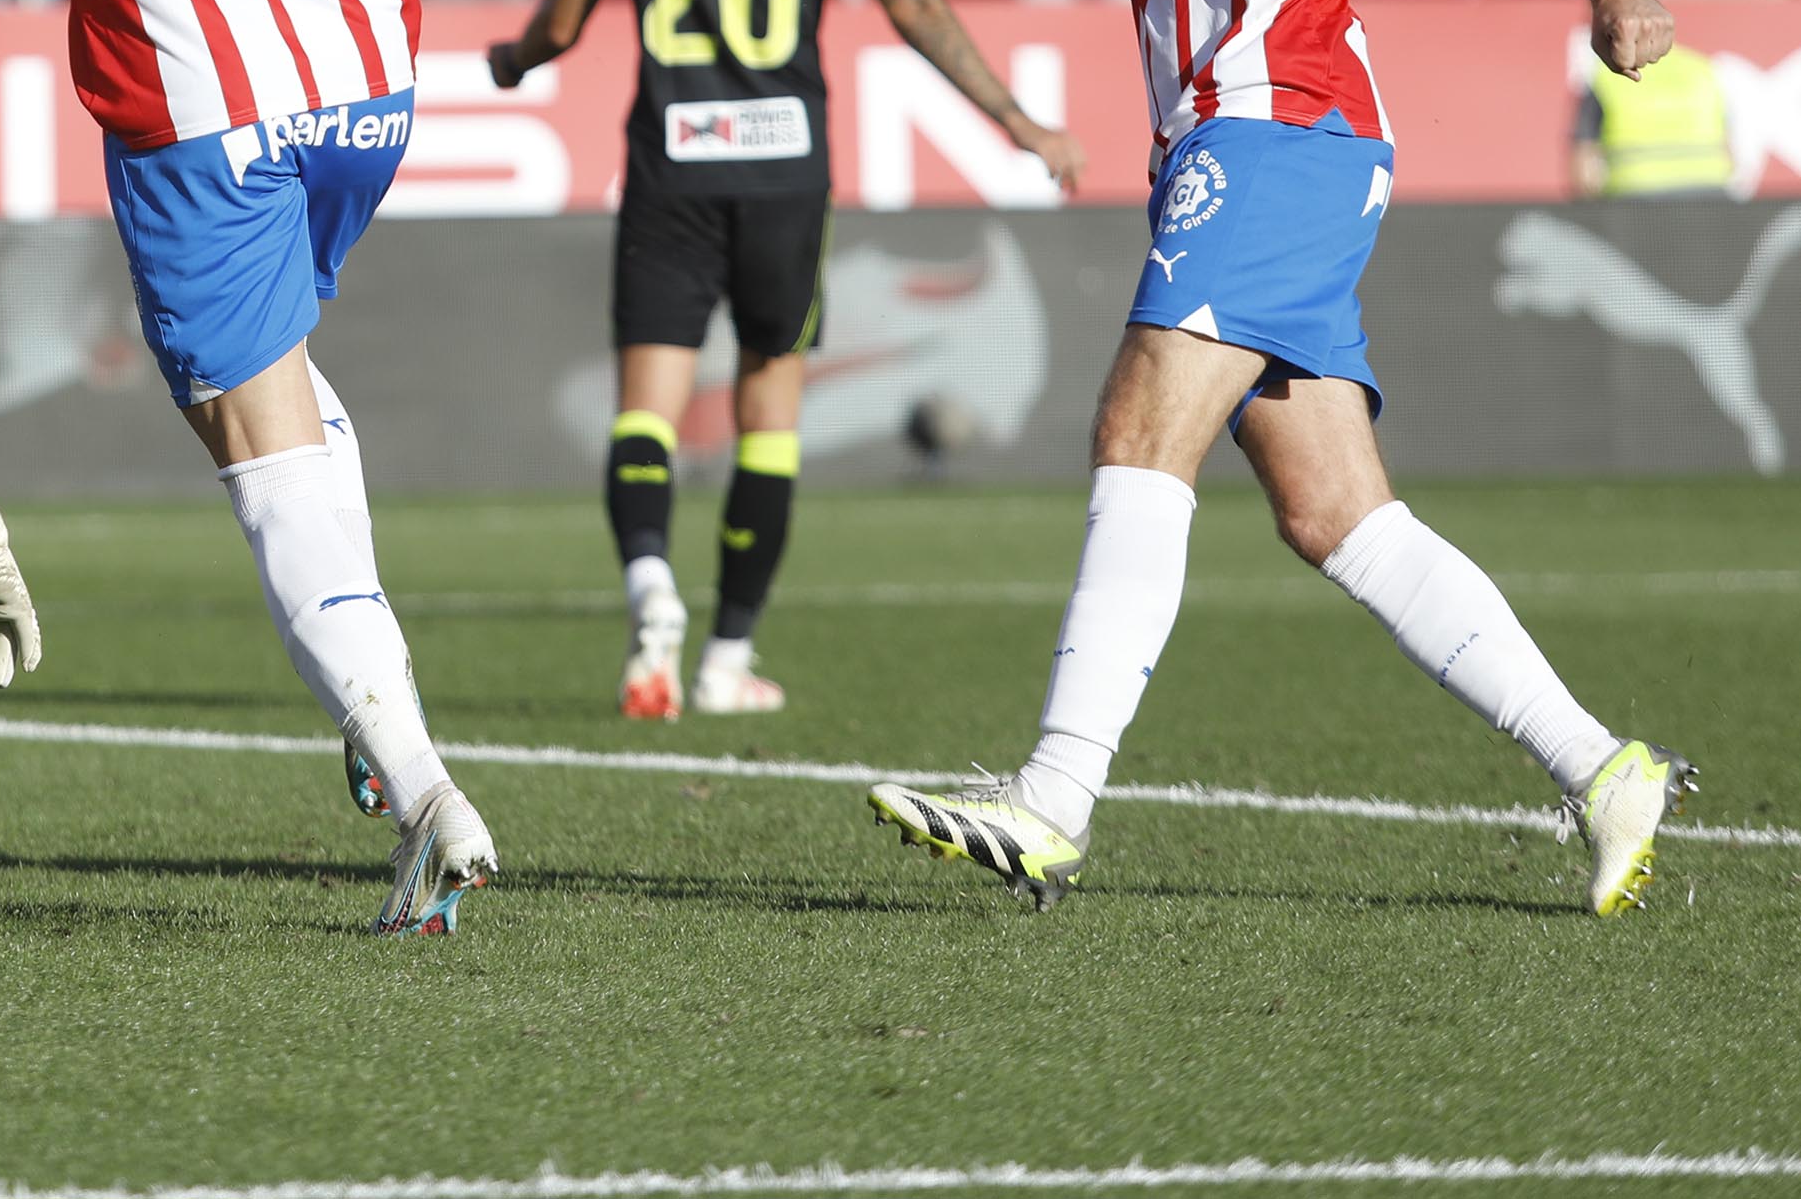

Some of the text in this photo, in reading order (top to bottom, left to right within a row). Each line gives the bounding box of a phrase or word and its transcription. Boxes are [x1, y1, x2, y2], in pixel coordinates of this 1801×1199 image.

[263, 104, 409, 164] parlem
[1195, 149, 1228, 191] Brava
[1164, 197, 1224, 234] de Girona
